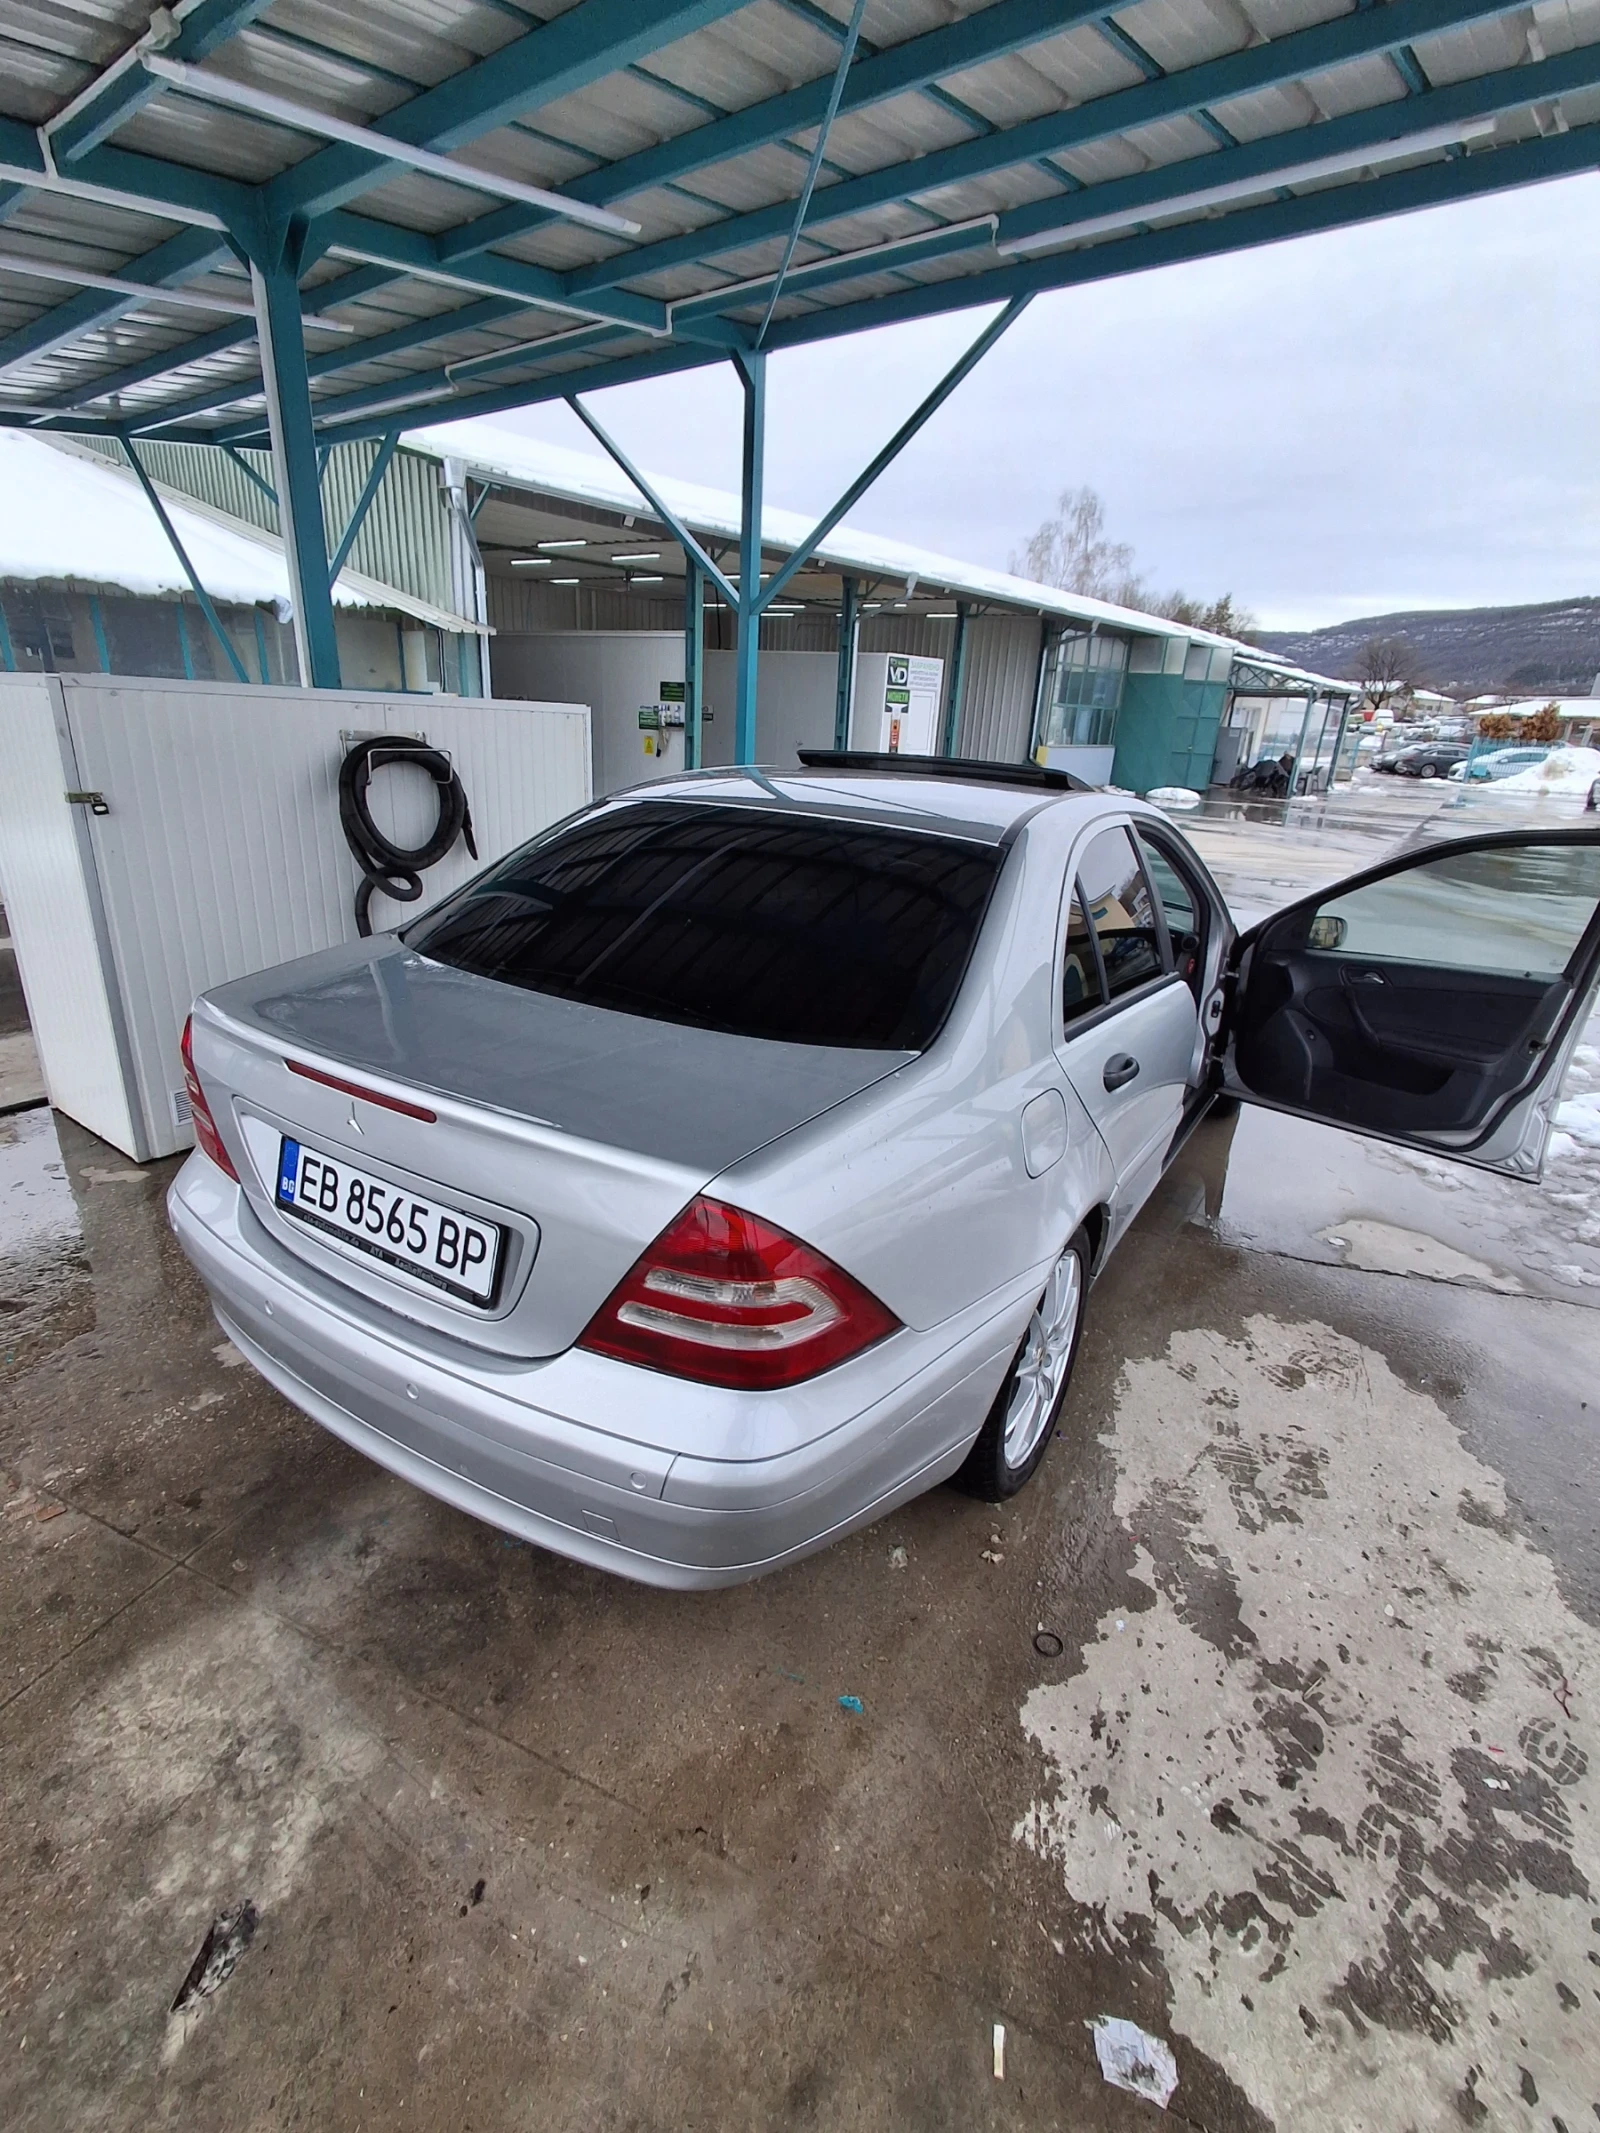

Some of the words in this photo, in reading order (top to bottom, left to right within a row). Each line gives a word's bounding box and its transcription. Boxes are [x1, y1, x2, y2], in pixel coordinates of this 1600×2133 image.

[890, 666, 907, 683] VD
[281, 1176, 295, 1194] BG
[299, 1155, 338, 1213] EB
[346, 1178, 429, 1254] 8565
[435, 1215, 487, 1277] BP
